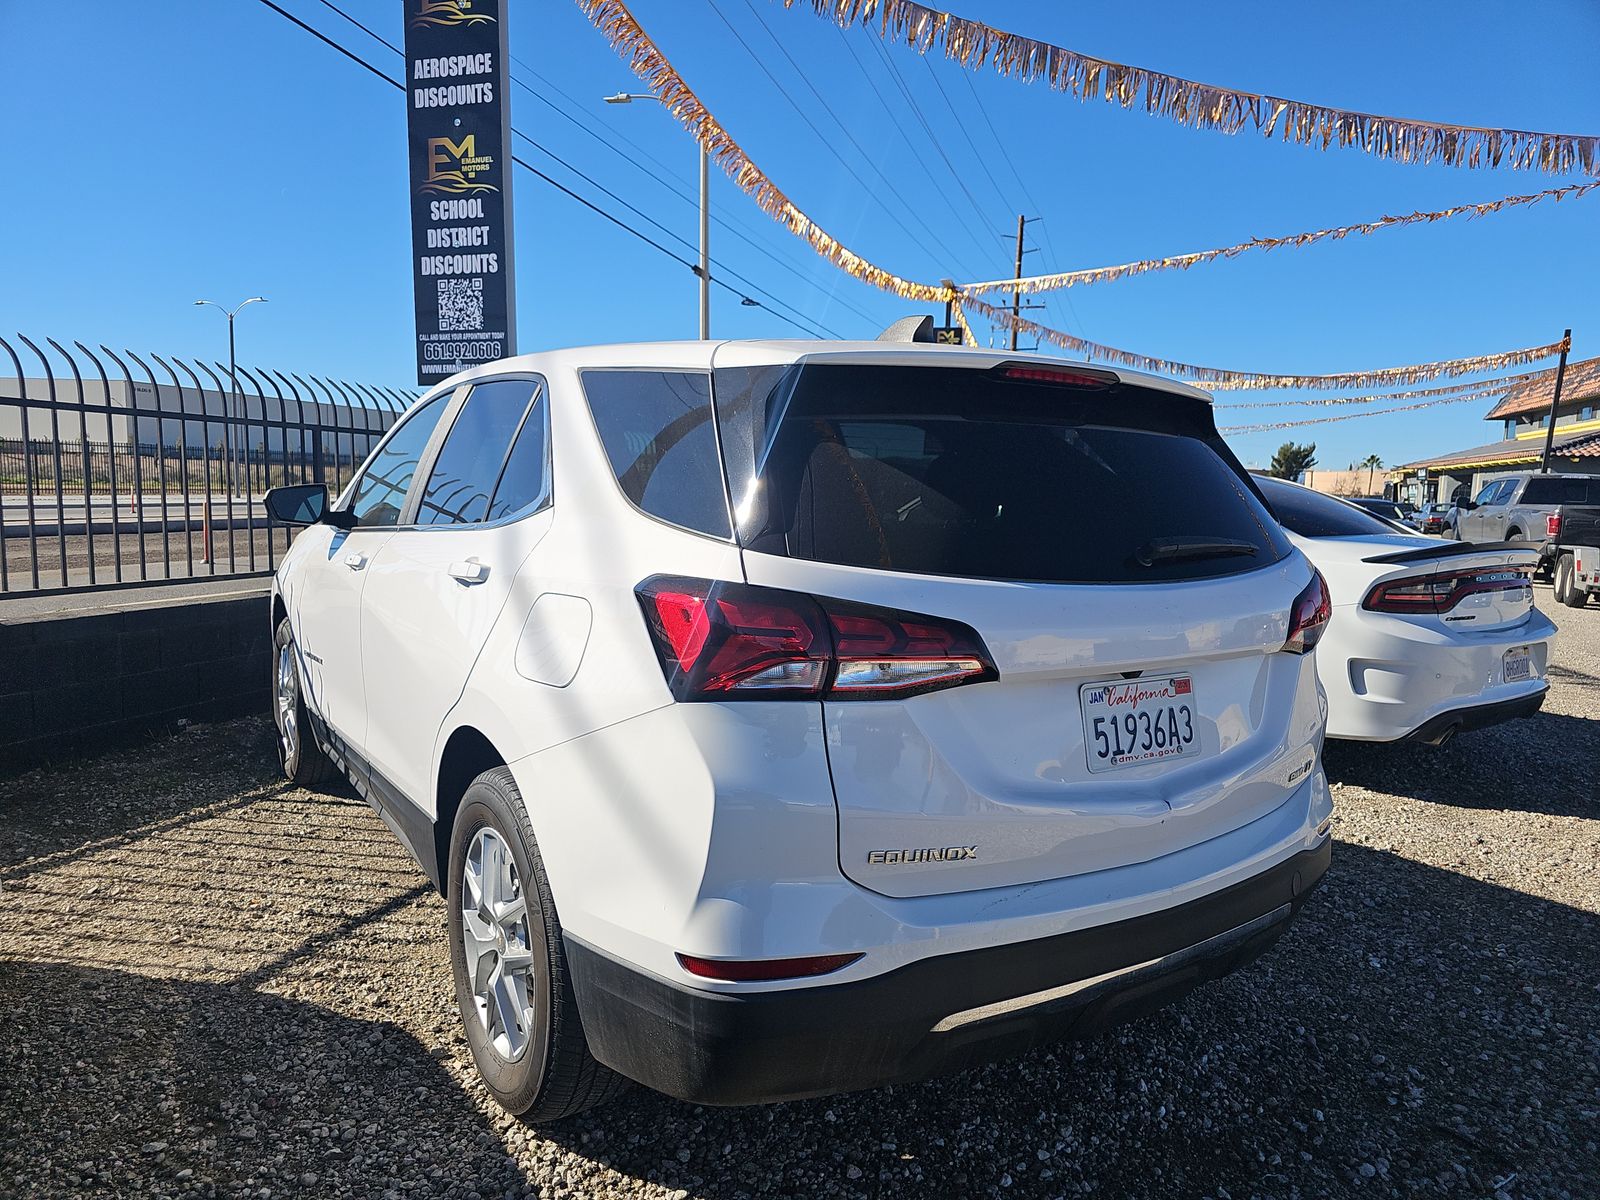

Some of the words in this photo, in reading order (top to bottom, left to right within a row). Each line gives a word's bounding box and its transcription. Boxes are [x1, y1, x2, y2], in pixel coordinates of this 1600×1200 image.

[414, 53, 493, 80] AEROSPACE
[414, 82, 493, 109] DISCOUNTS
[461, 155, 494, 165] EMANUEL
[461, 164, 490, 172] MOTORS
[430, 198, 485, 221] SCHOOL
[427, 226, 490, 249] DISTRICT
[421, 253, 499, 276] DISCOUNTS
[419, 333, 430, 341] CALL
[430, 333, 439, 341] AND
[439, 333, 451, 341] MAKE
[451, 332, 463, 340] YOUR
[463, 332, 491, 340] APPOINTMENT
[491, 331, 505, 339] TODAY
[424, 341, 502, 360] 661.992.0606
[1089, 690, 1105, 704] JAN
[1107, 682, 1176, 709] California
[1093, 705, 1194, 759] 51936A3
[1118, 747, 1176, 763] dmv.ca.gov
[868, 845, 978, 865] EQUINOX
